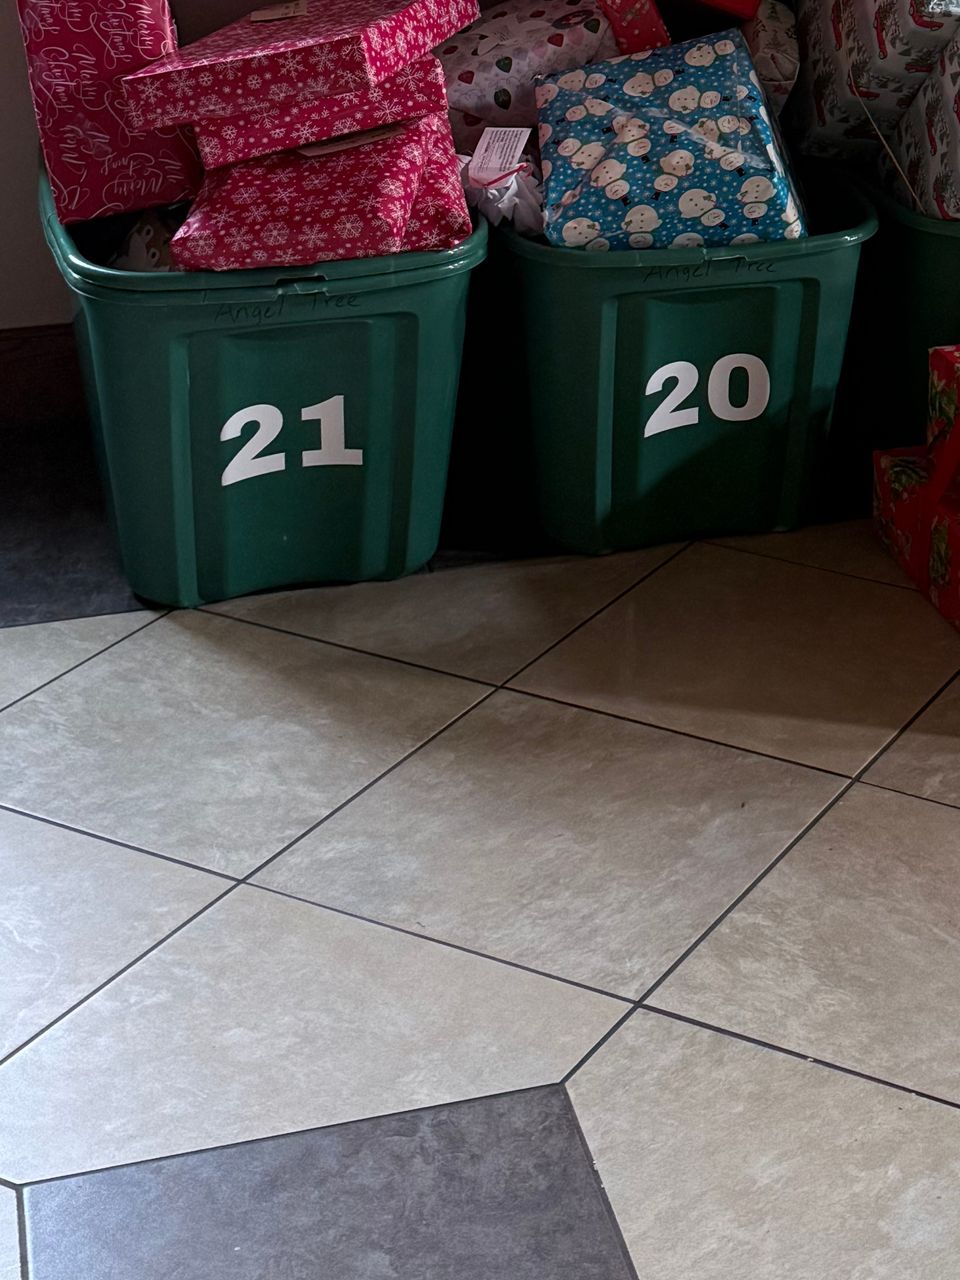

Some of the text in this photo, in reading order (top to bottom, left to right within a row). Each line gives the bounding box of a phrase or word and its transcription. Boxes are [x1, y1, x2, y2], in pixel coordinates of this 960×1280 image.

[73, 43, 105, 107] Merry
[643, 259, 777, 282] Angel Tree
[214, 293, 361, 326] Angel Tree
[644, 353, 770, 438] 20
[220, 395, 363, 486] 21
